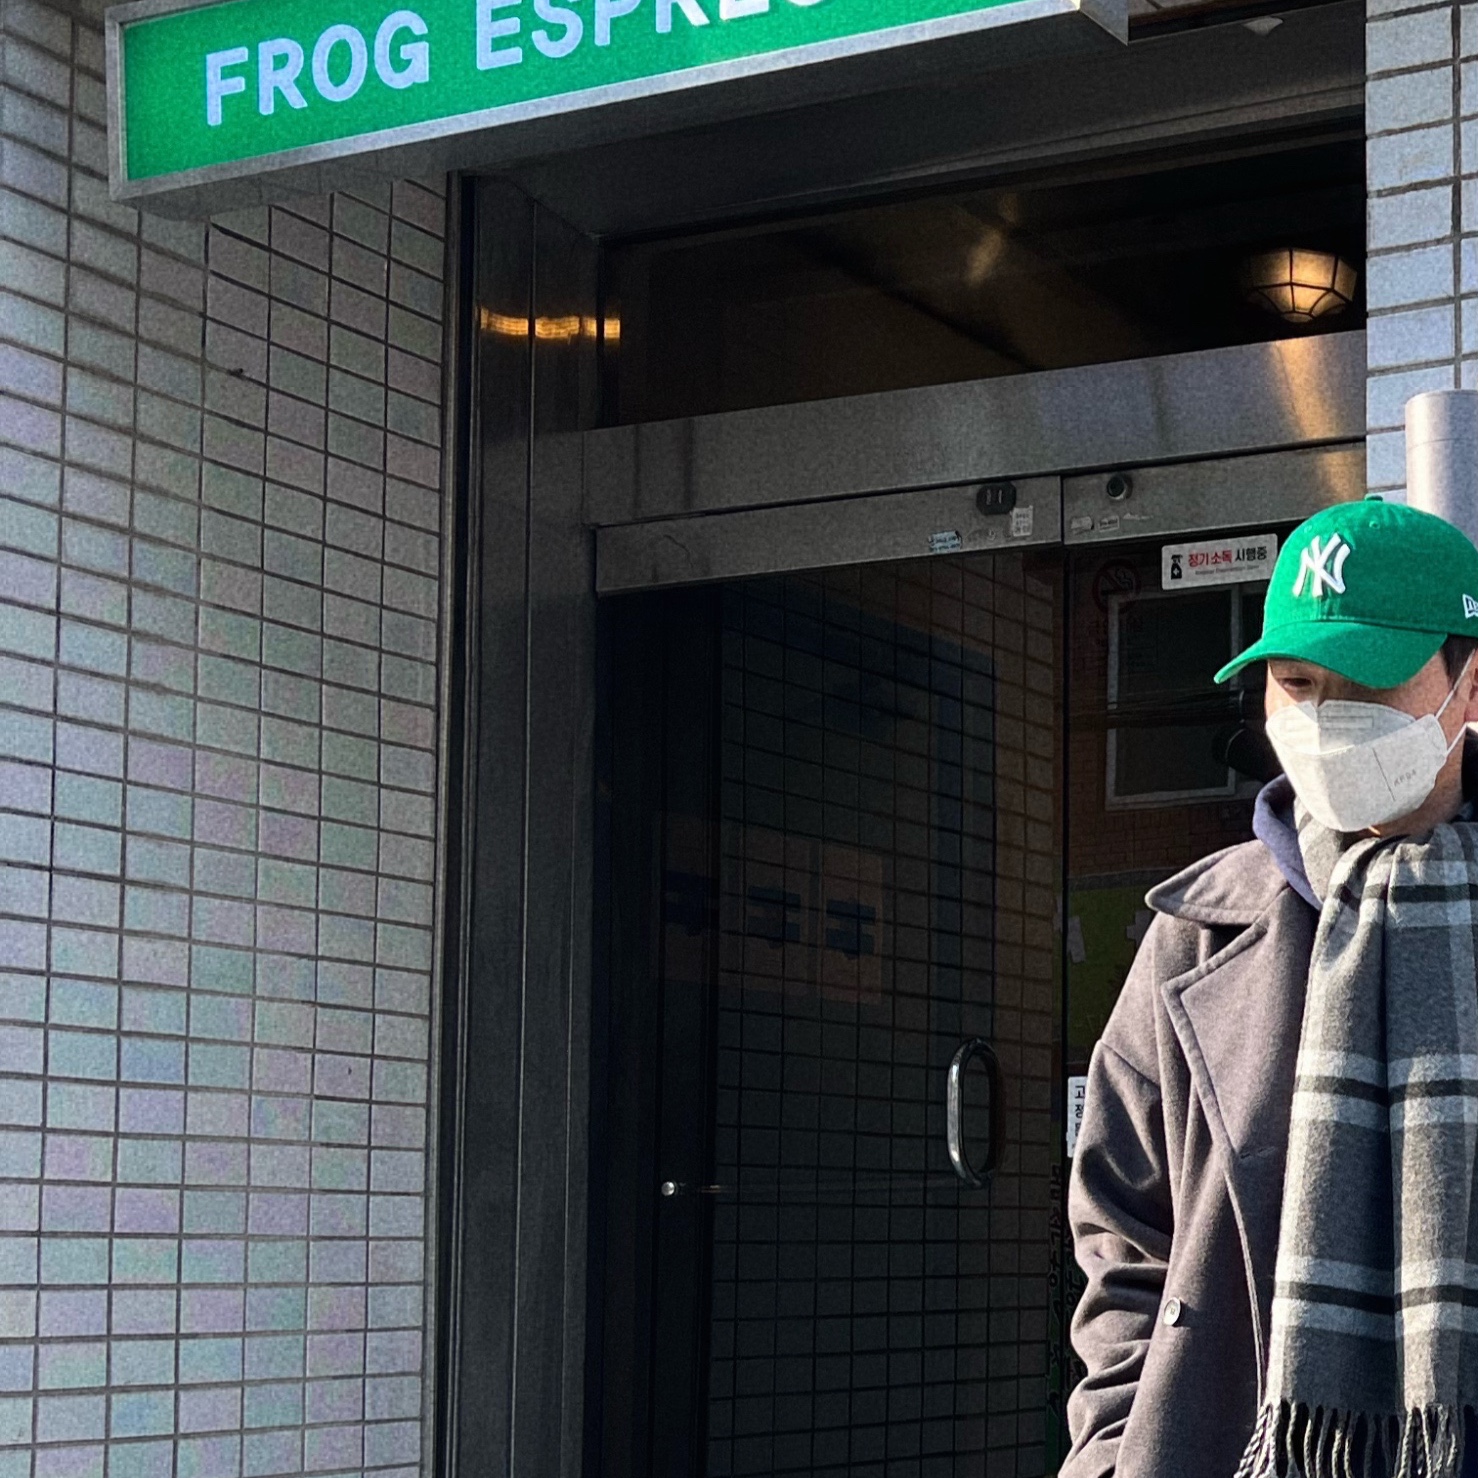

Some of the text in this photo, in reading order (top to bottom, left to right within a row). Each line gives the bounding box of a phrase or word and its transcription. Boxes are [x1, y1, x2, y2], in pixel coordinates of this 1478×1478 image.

[205, 0, 827, 126] FROG ESP
[1188, 546, 1267, 568] 정기 소독 시행중
[1292, 532, 1351, 598] NY
